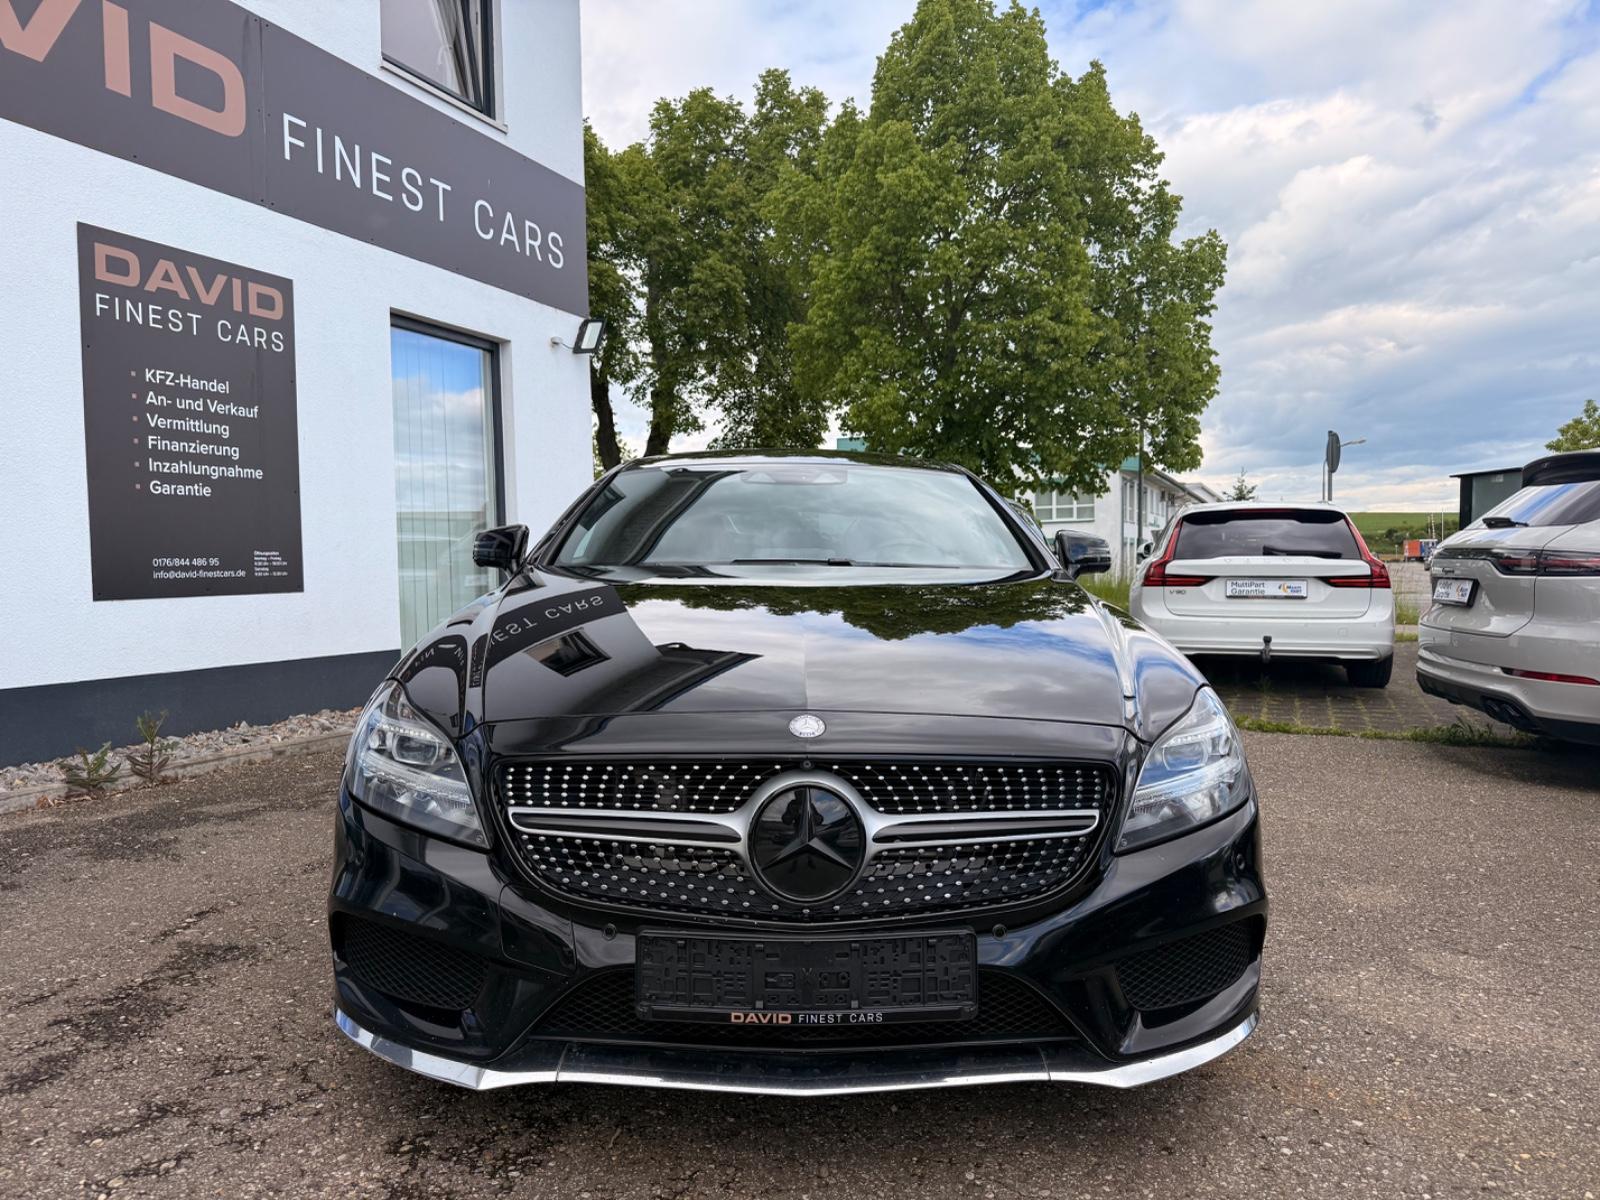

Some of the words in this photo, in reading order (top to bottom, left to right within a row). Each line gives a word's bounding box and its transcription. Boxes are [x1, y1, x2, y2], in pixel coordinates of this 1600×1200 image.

[283, 112, 451, 221] FINEST
[474, 199, 564, 269] CARS
[94, 242, 284, 320] DAVID
[96, 293, 202, 335] FINEST
[217, 320, 284, 352] CARS
[145, 368, 230, 394] KFZ-Handel
[146, 391, 172, 407] An-
[176, 398, 203, 412] und
[207, 399, 259, 419] Verkauf
[147, 413, 230, 438] Vermittlung
[148, 435, 240, 460] Finanzierung
[148, 458, 263, 479] Inzahlungnahme
[150, 480, 212, 497] Garantie
[153, 569, 246, 579] info@david-finestcars.de
[209, 557, 220, 566] 95
[731, 1012, 791, 1024] DAVID
[799, 1013, 842, 1024] FINEST
[850, 1012, 883, 1023] CARS
